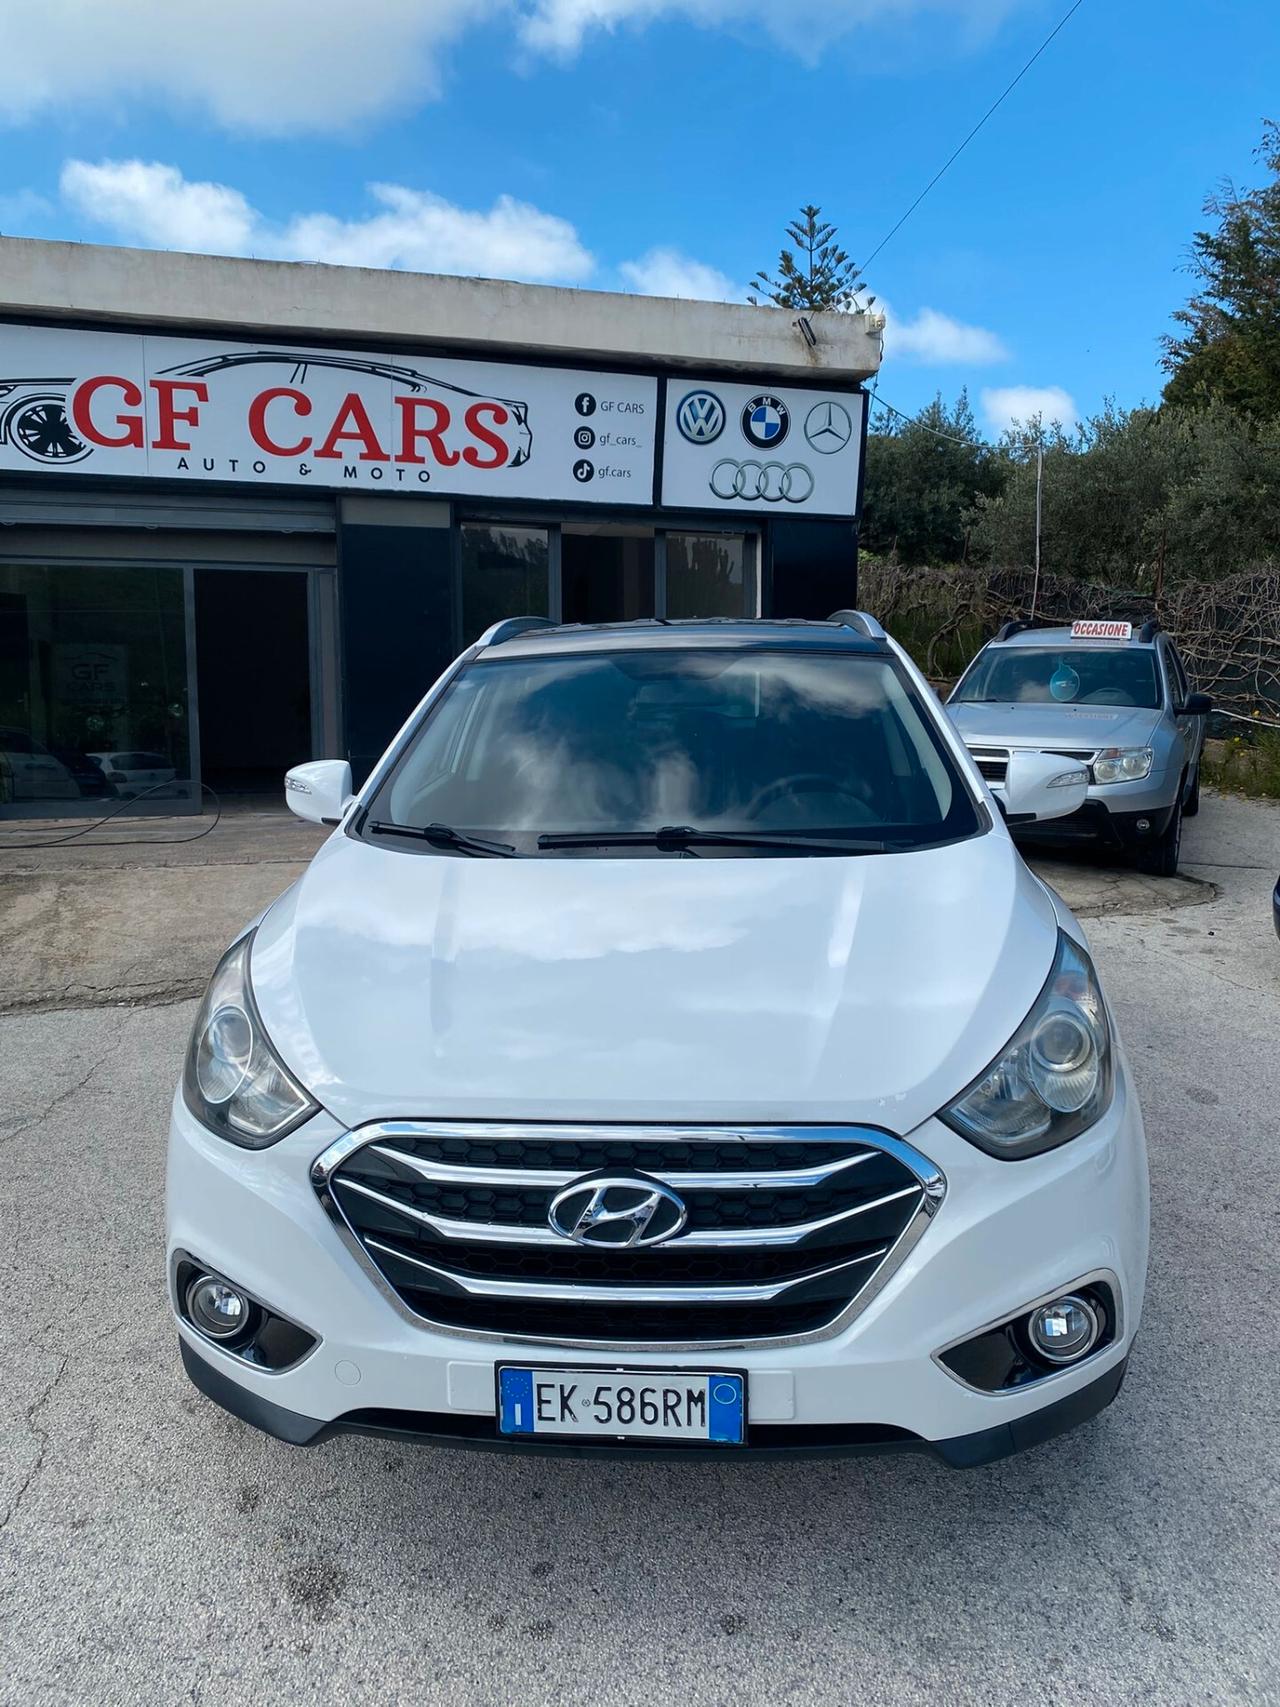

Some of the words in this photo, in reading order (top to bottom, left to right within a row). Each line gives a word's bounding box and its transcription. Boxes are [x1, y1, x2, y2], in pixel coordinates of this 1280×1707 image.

[600, 401, 615, 413] GF
[617, 402, 645, 415] CARS
[748, 397, 786, 416] BMW
[72, 375, 209, 451] GF
[248, 387, 510, 470] CARS
[599, 432, 643, 448] gf_cars_
[177, 457, 266, 474] AUTO
[299, 463, 312, 476] &
[343, 466, 431, 483] MOTO
[598, 466, 632, 479] gf.cars
[1074, 623, 1128, 636] OCCASIONE
[536, 1383, 578, 1423] EK
[593, 1386, 706, 1427] 586RM
